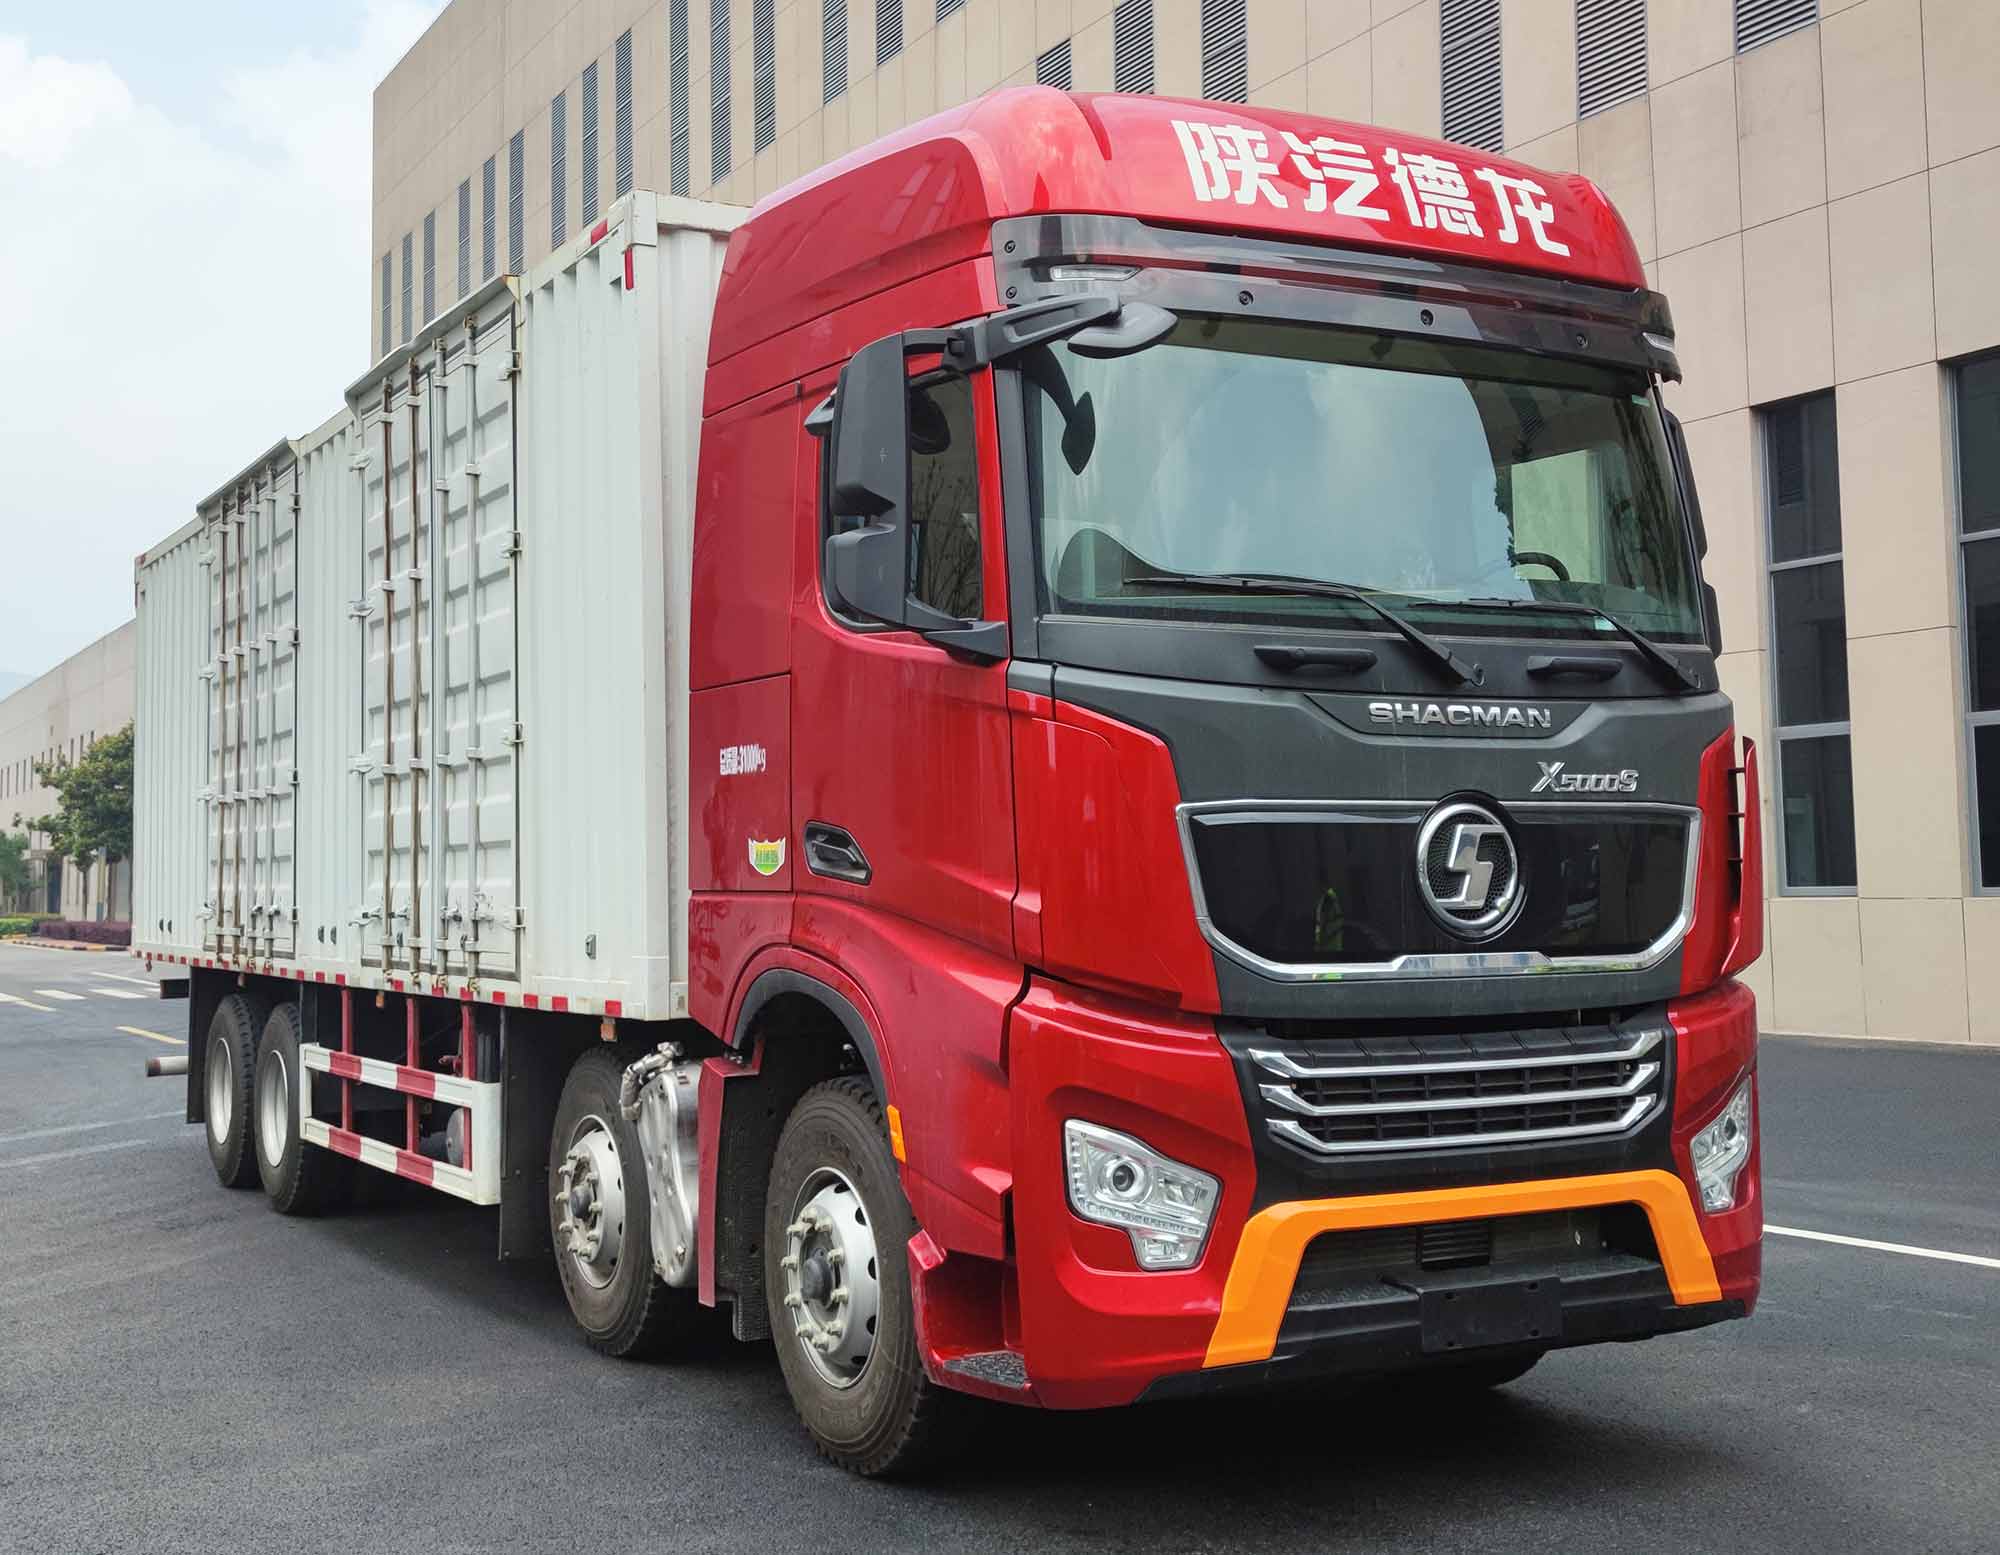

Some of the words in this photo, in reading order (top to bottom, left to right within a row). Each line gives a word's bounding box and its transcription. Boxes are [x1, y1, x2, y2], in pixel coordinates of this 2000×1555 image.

[1171, 119, 1570, 257] 陕汽德龙
[1368, 702, 1552, 730] SHACMAN
[1531, 761, 1639, 794] X5000S
